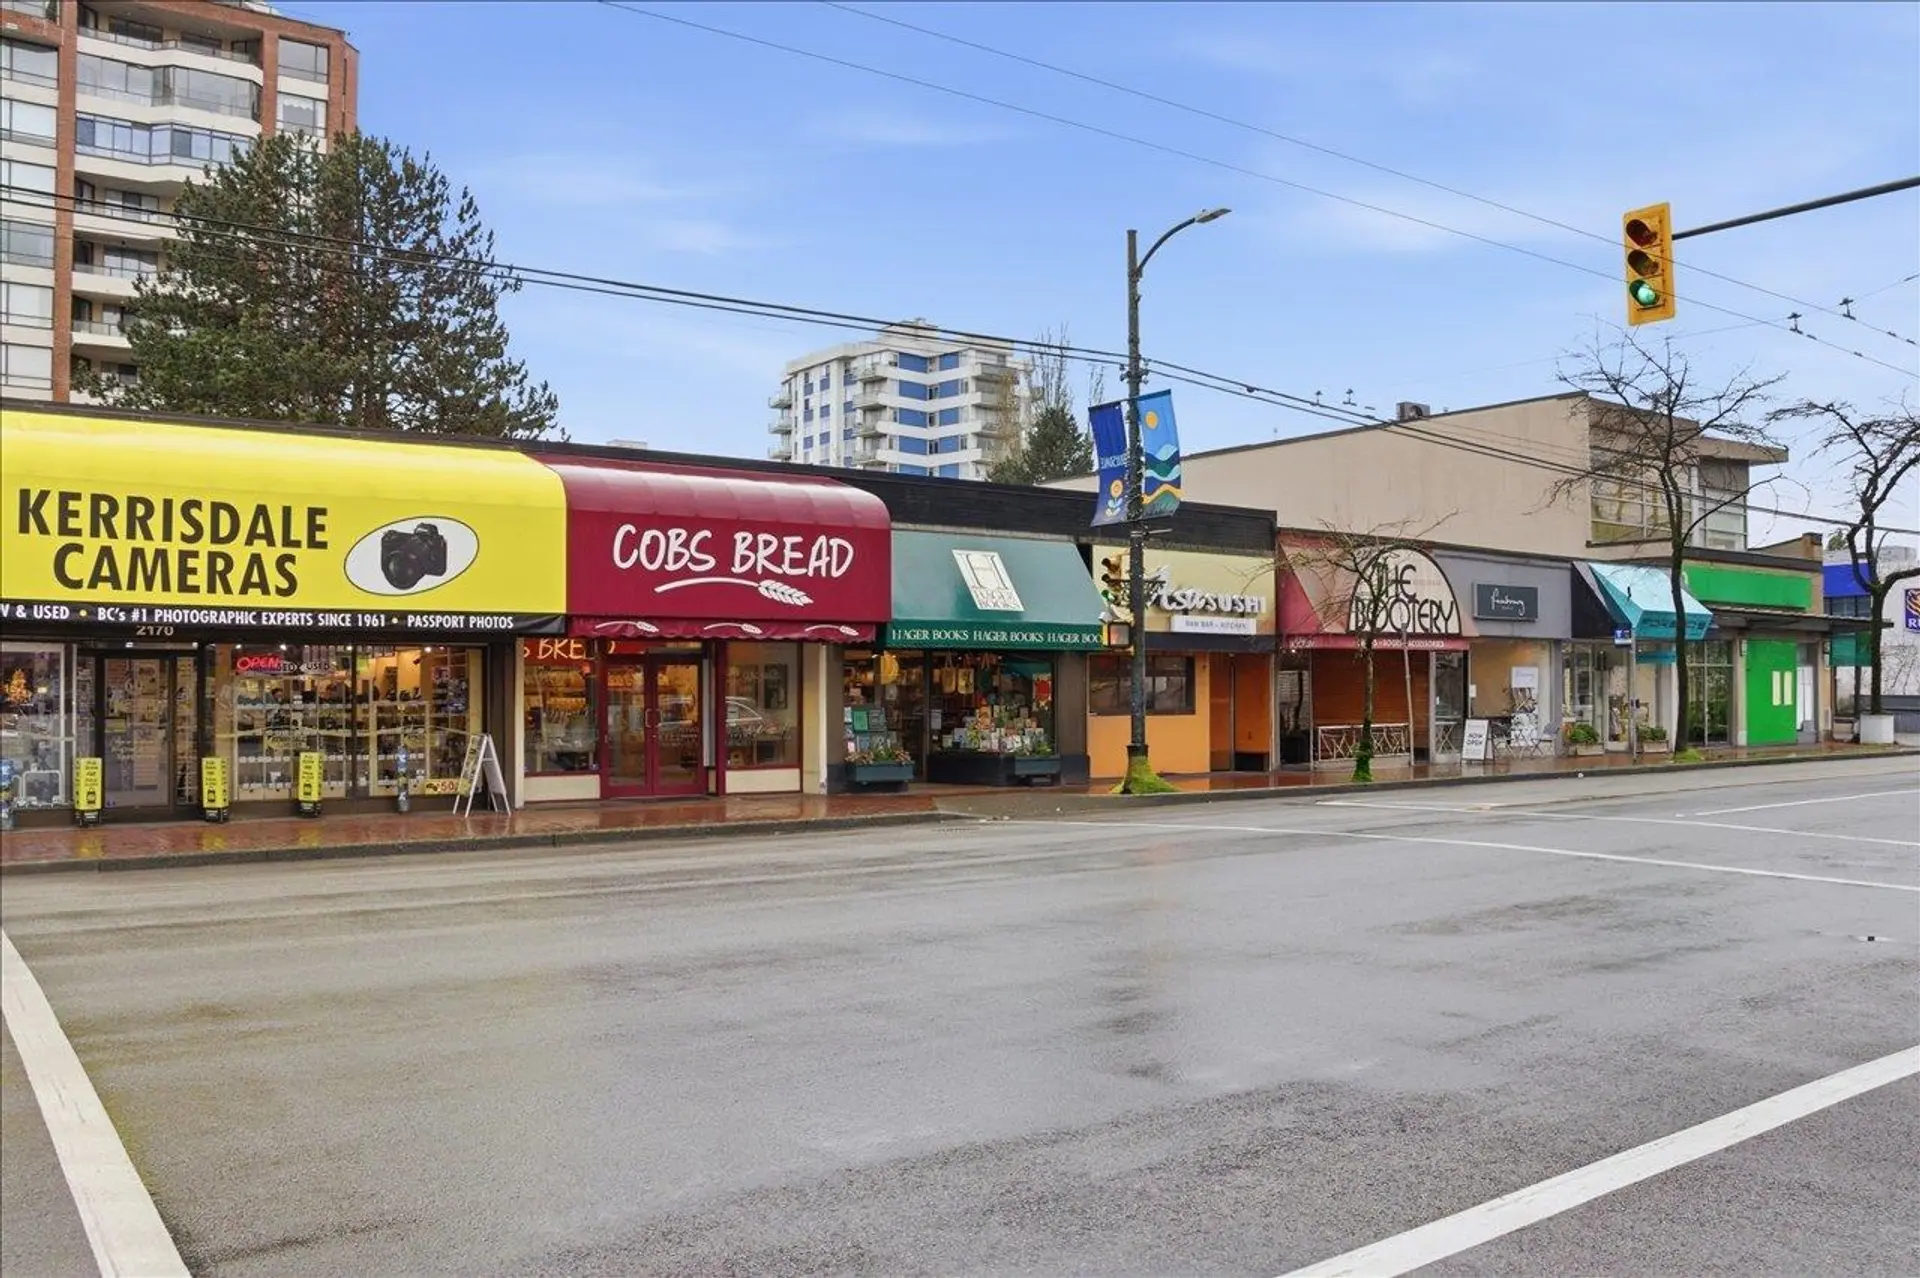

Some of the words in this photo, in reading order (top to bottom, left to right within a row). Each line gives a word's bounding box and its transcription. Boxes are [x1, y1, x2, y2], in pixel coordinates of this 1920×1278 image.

[18, 488, 328, 550] KERRISDALE
[613, 523, 716, 572] COBS
[731, 532, 854, 578] BREAD
[53, 542, 298, 597] CAMERAS
[33, 605, 70, 620] USED
[131, 609, 147, 622] #1
[154, 609, 257, 625] PHOTOGRAPHIC
[261, 612, 313, 626] EXPERTS
[318, 613, 351, 627] SINCE
[357, 614, 386, 627] 1961
[407, 615, 464, 629] PASSPORT
[469, 616, 514, 629] PHOTOS
[136, 625, 174, 636] 2170
[1355, 598, 1454, 634] BOOTERY
[892, 629, 930, 641] HAGER
[932, 629, 969, 641] BOOKS
[973, 630, 1008, 642] HAGER
[1010, 631, 1044, 643] BOOKS
[1047, 632, 1080, 643] HAGER
[236, 654, 281, 670] OPEN
